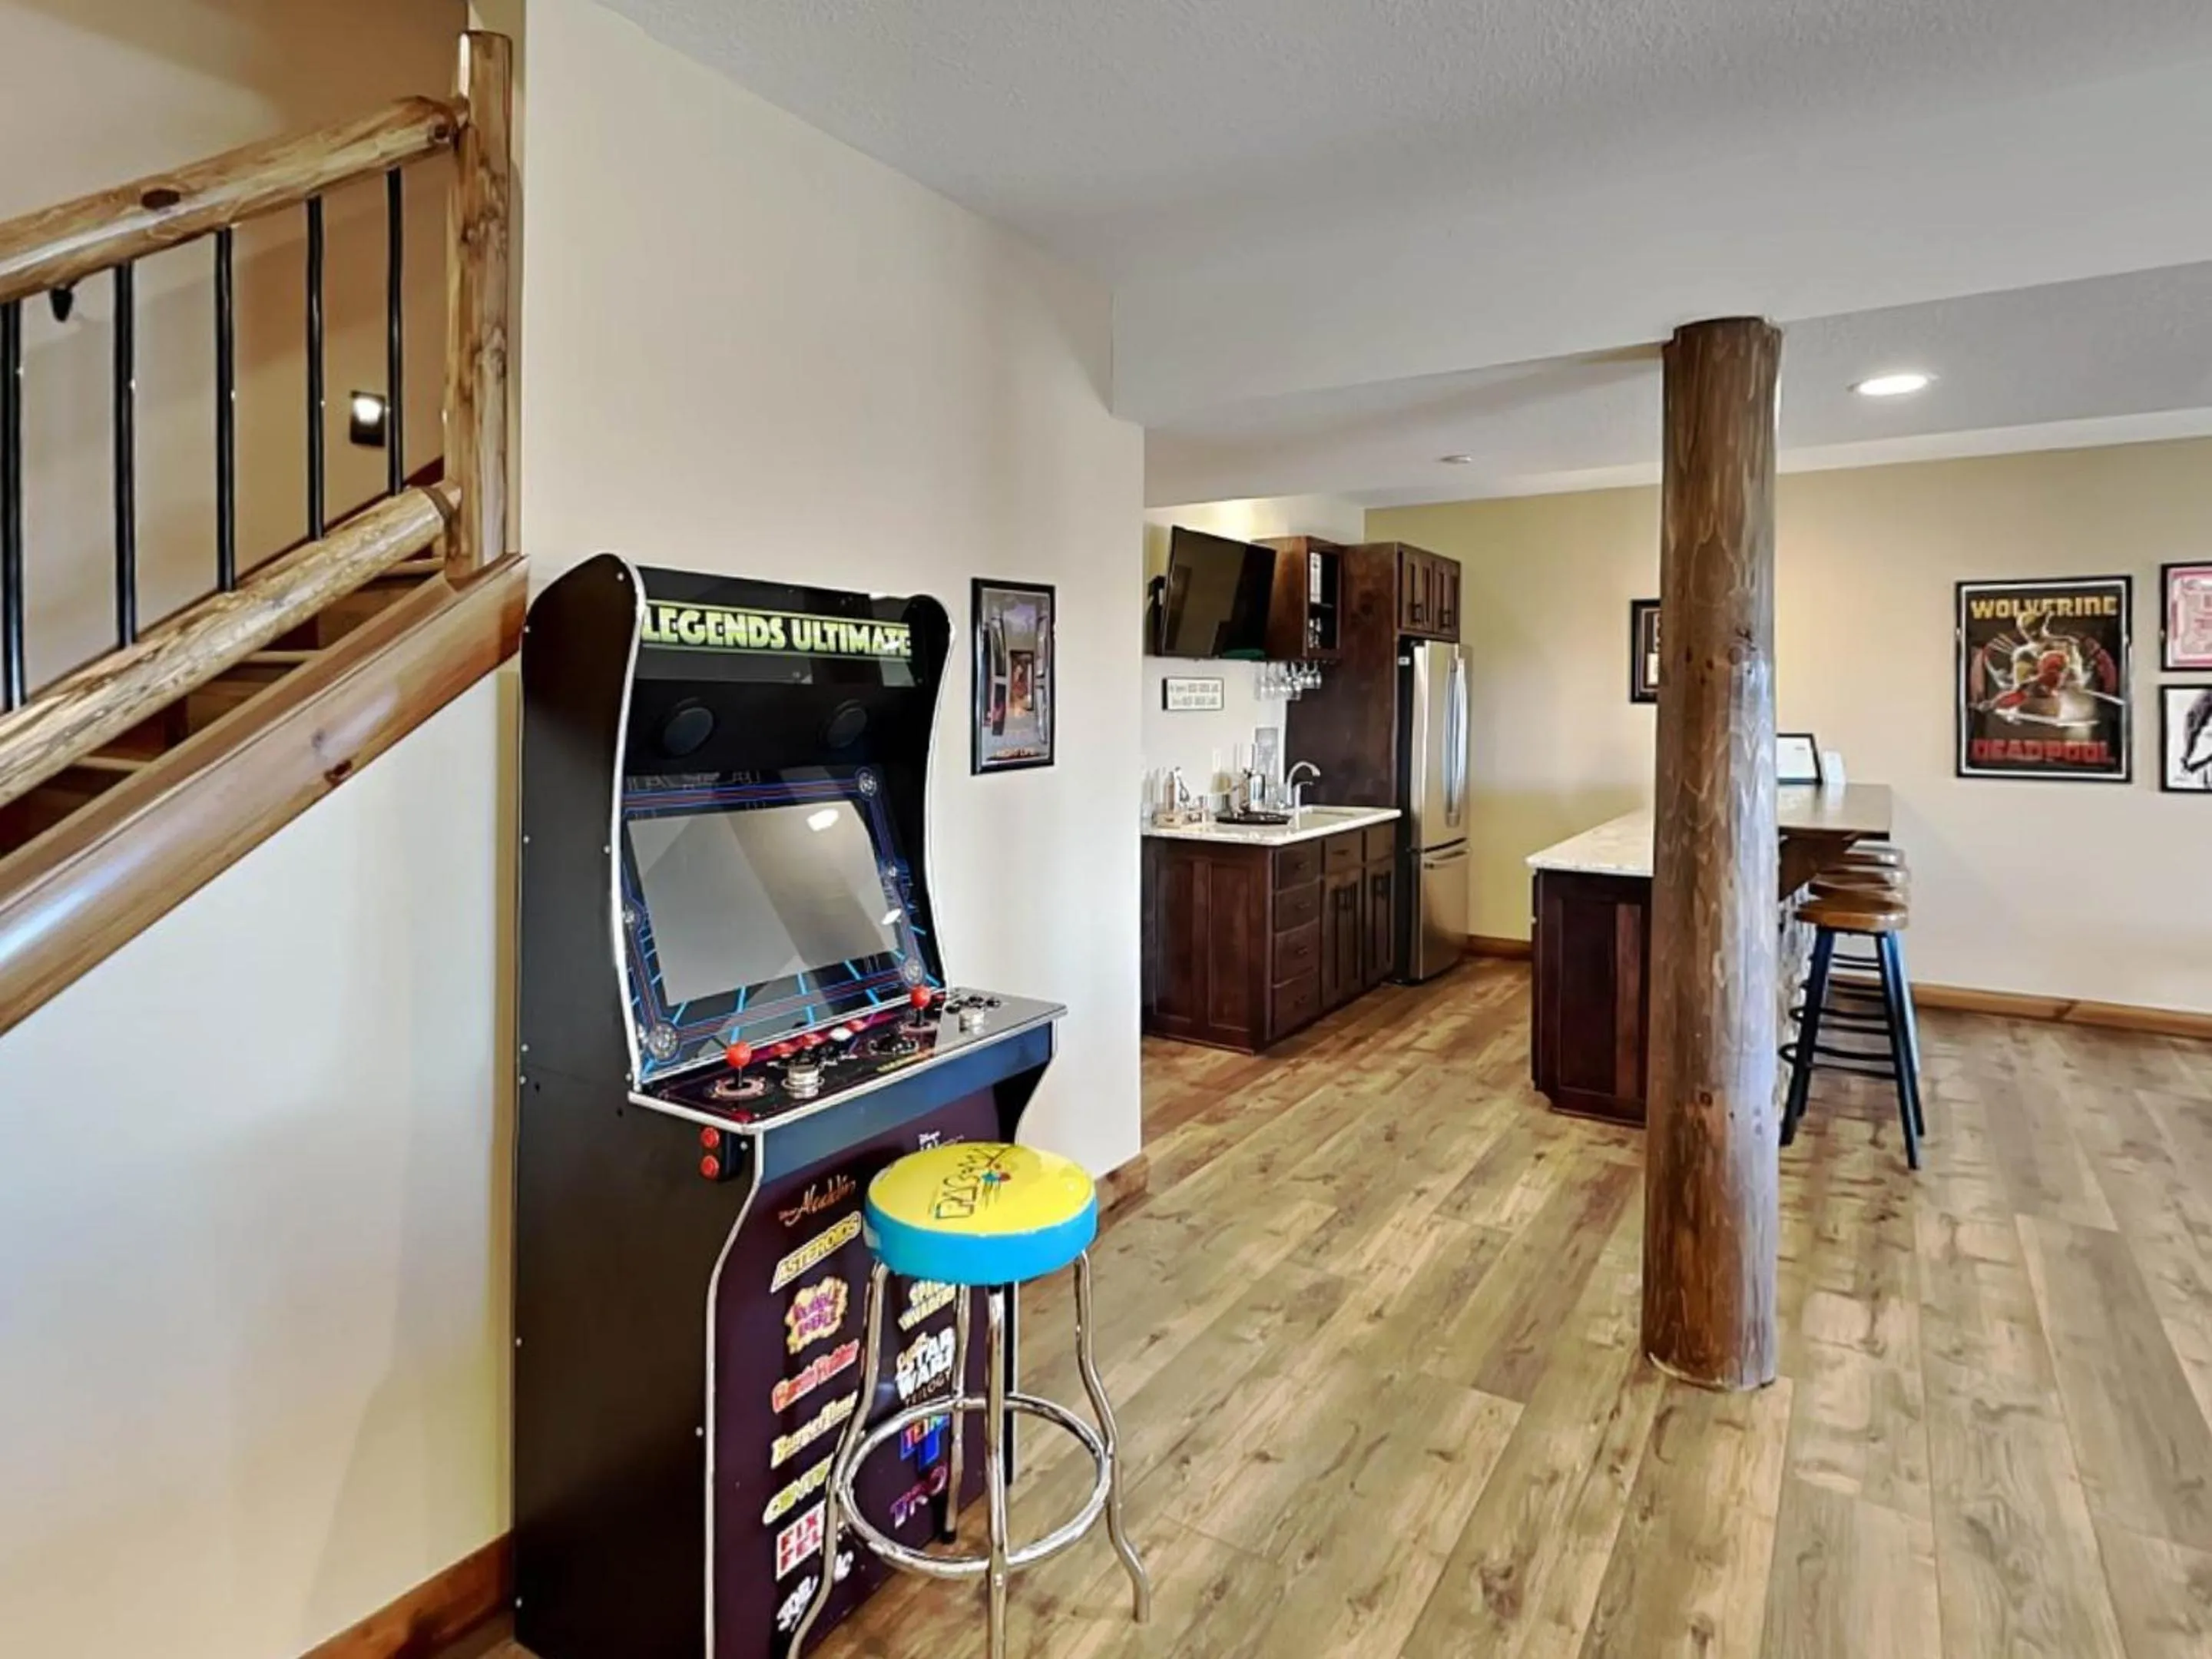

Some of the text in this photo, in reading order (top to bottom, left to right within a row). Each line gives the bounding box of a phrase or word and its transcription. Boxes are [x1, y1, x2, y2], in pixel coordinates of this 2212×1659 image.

[641, 604, 912, 657] LEGENDS ULTIMATE
[1970, 595, 2118, 619] WOLVERINE
[1972, 739, 2112, 763] DEADPOOL
[777, 1209, 861, 1284] ASTEROIDS
[889, 1462, 949, 1528] TRO
